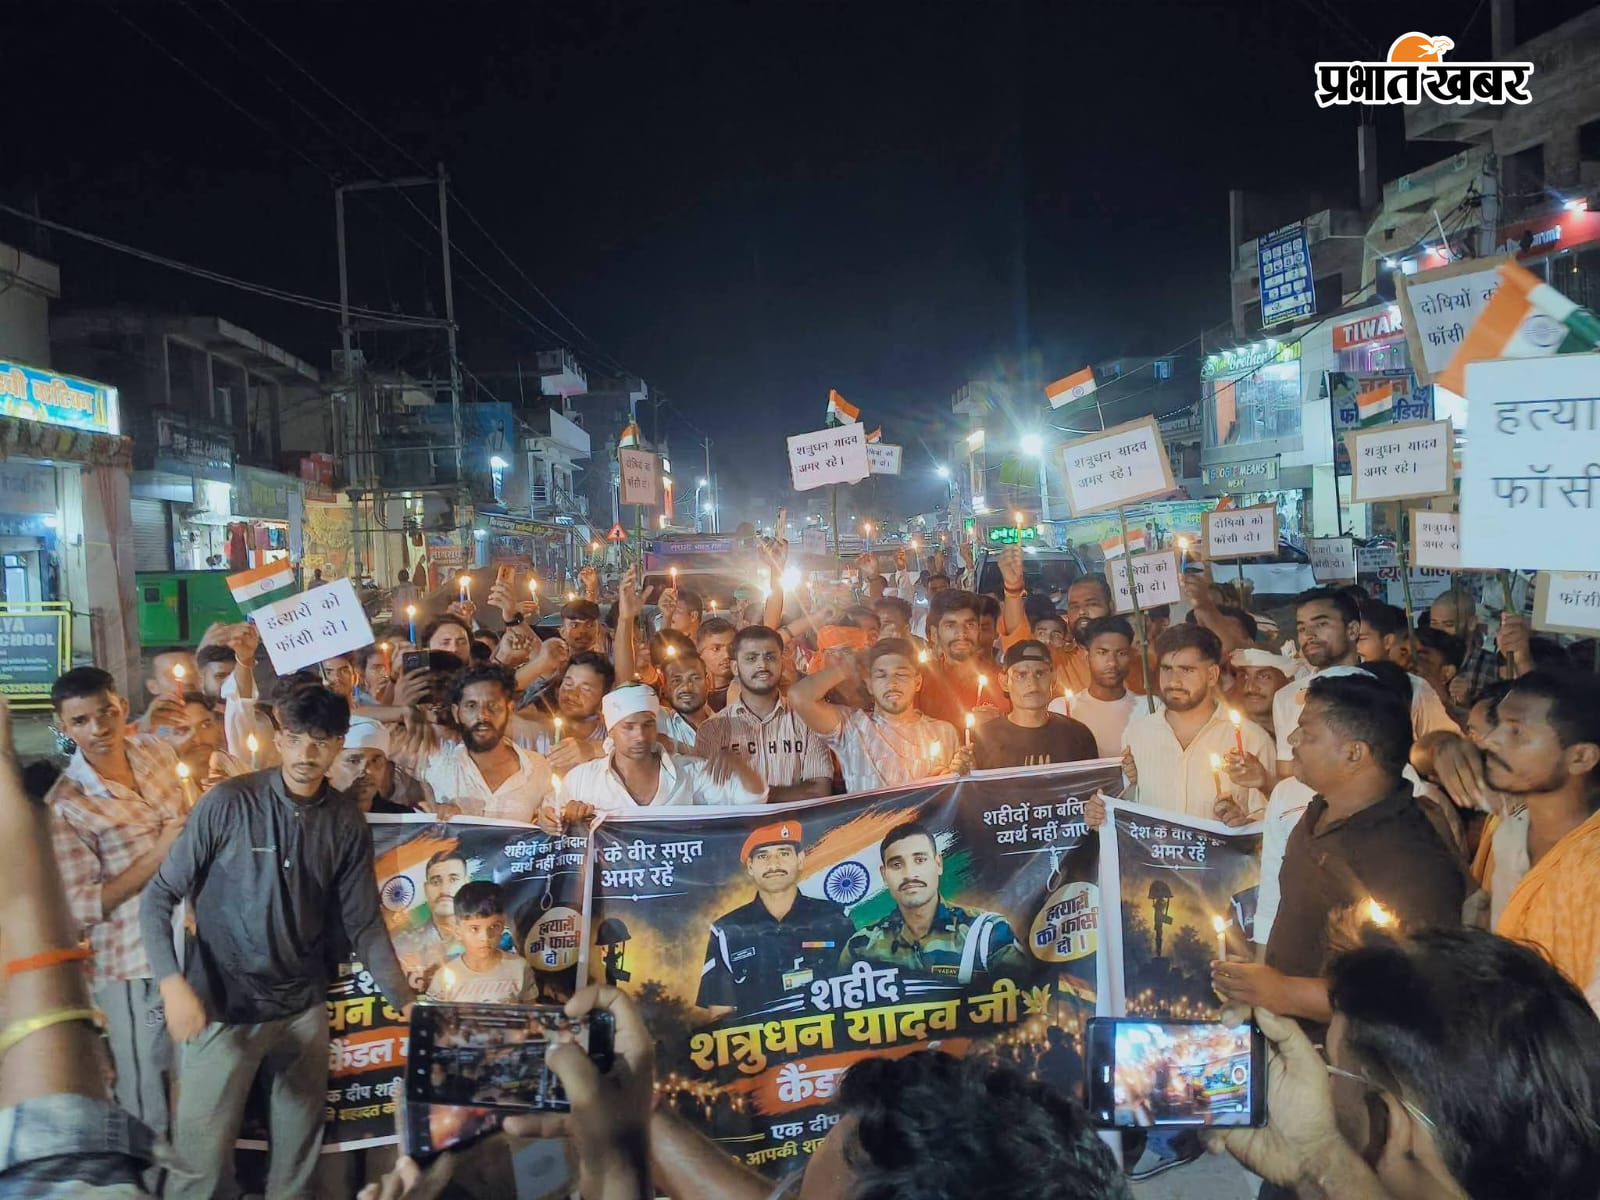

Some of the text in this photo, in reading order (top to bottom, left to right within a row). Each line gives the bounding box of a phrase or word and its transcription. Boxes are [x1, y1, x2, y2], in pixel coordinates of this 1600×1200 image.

[1343, 307, 1402, 343] TIWAR
[1493, 397, 1600, 436] हत्या
[834, 435, 859, 447] यादव
[1118, 440, 1148, 457] यादव
[1408, 438, 1438, 452] यादव
[800, 461, 820, 473] अमर
[1363, 466, 1388, 478] अमर
[1078, 474, 1104, 488] अमर
[0, 616, 25, 633] YA
[0, 633, 55, 647] CHOOL
[984, 796, 1089, 826] शहीदों का बलि
[996, 820, 1090, 844] व्यर्थ नहीं जाए
[1129, 821, 1151, 840] देश
[503, 840, 538, 858] शहीदों
[537, 842, 553, 855] का
[603, 839, 704, 865] के वीर सपूत
[1151, 841, 1206, 863] अमर रहें
[510, 858, 535, 874] व्यर्थ
[535, 854, 556, 872] नहीं
[601, 861, 674, 888] अमर रहें
[529, 936, 545, 954] को
[1036, 923, 1057, 946] को
[809, 961, 900, 1012] शहीद
[844, 999, 961, 1045] यादव
[967, 977, 1022, 1022] जी
[328, 1037, 396, 1072] कैंडल
[327, 1076, 402, 1103] क दीप शही
[775, 1062, 845, 1104] कैंड
[769, 1121, 804, 1140] एक
[745, 1140, 799, 1166] आपकी
